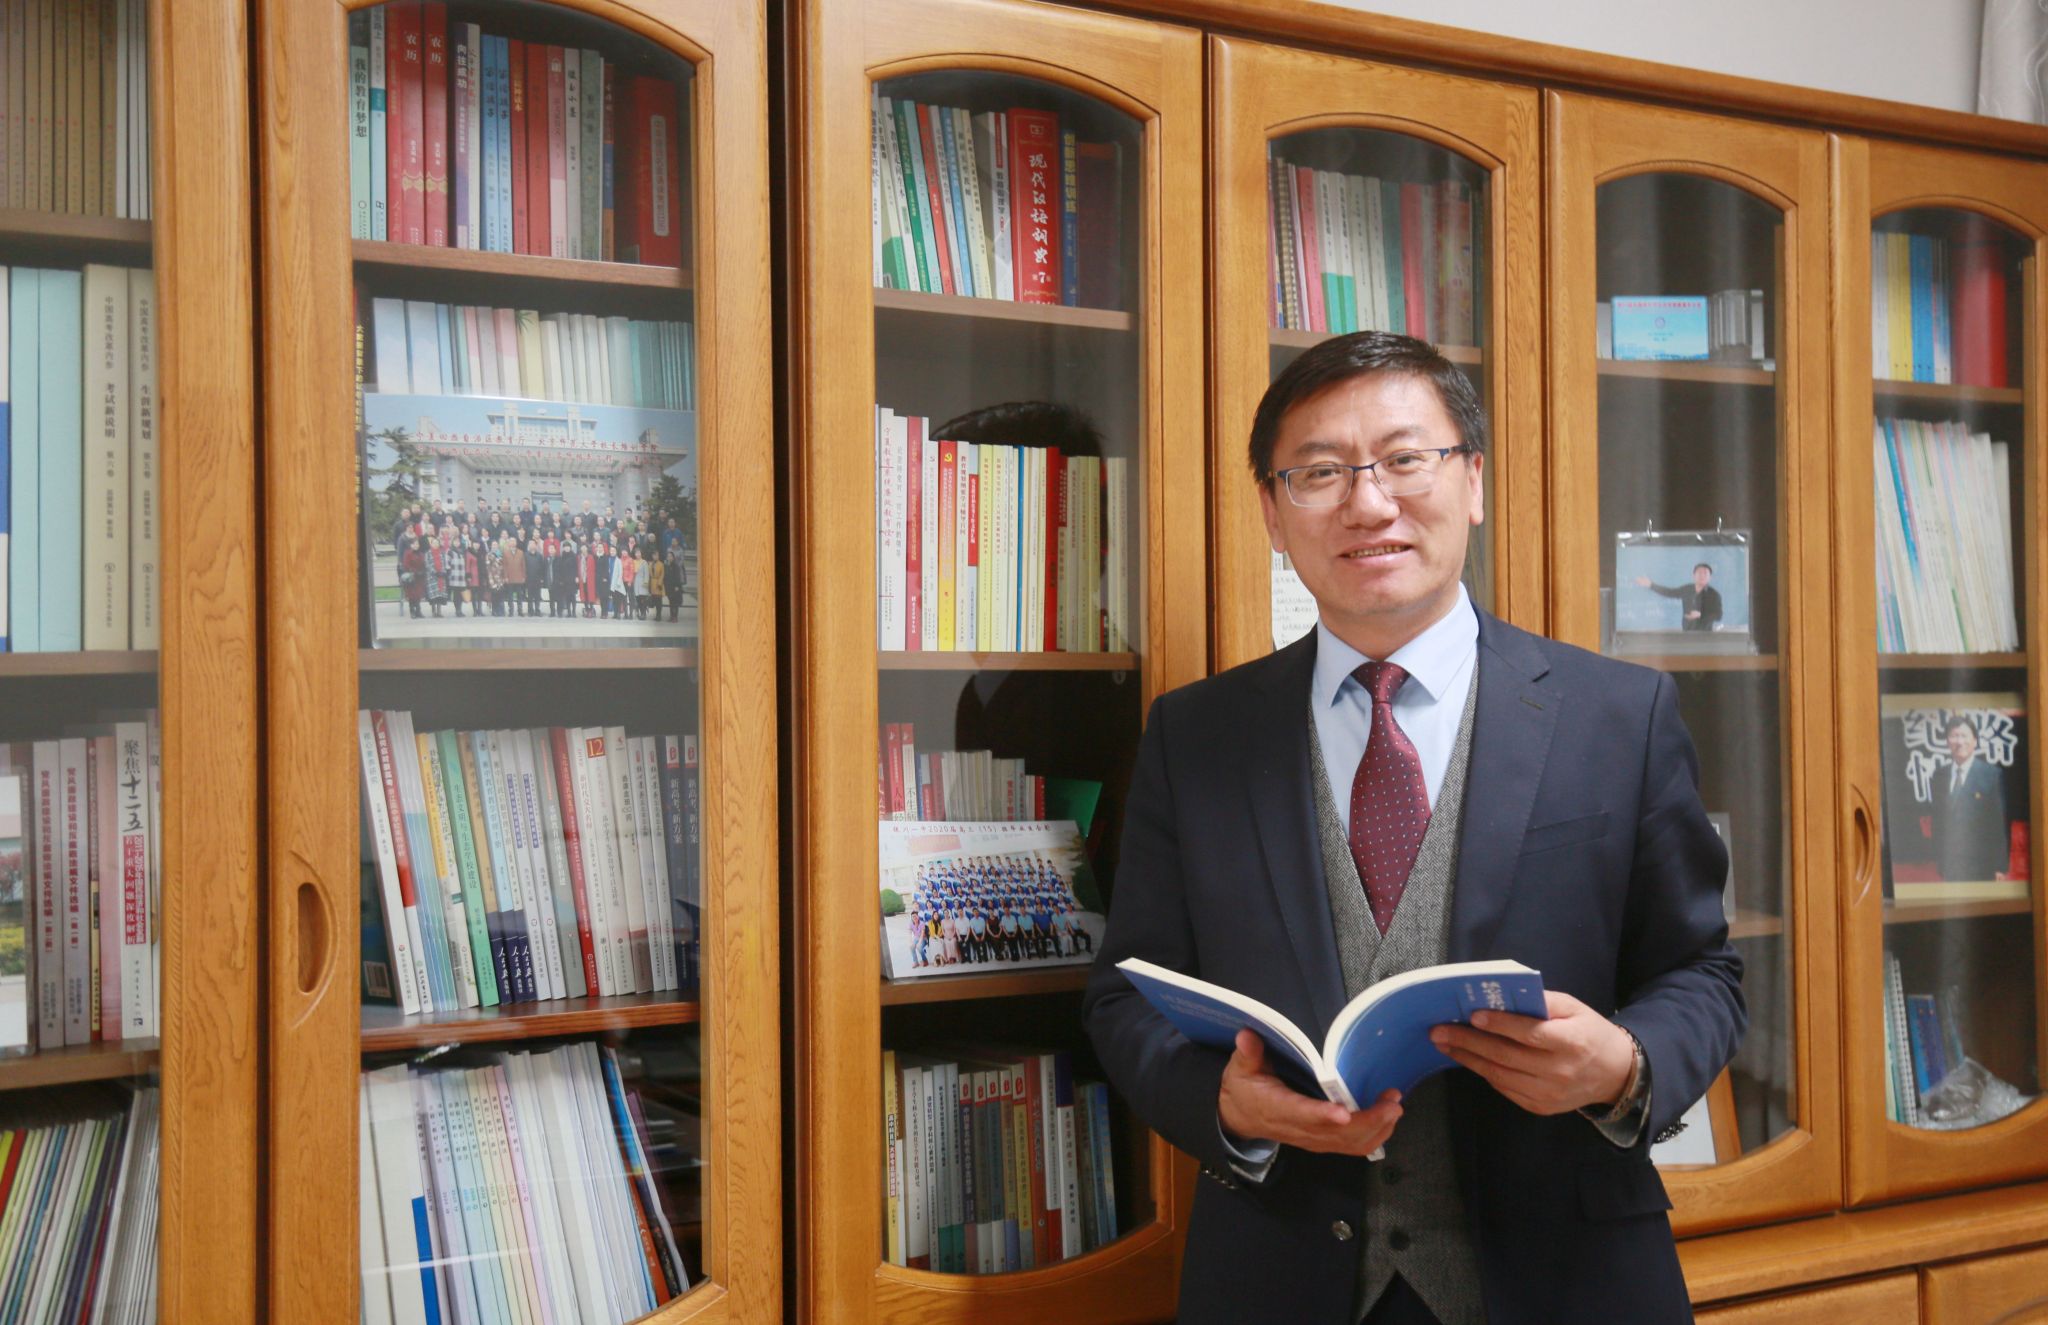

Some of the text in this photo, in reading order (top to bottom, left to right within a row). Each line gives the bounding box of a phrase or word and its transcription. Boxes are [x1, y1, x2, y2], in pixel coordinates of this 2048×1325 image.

[354, 57, 368, 138] 我的教育梦想
[1029, 153, 1049, 265] 现代汉语词典
[120, 738, 146, 832] 聚焦十二五
[588, 739, 604, 757] 12
